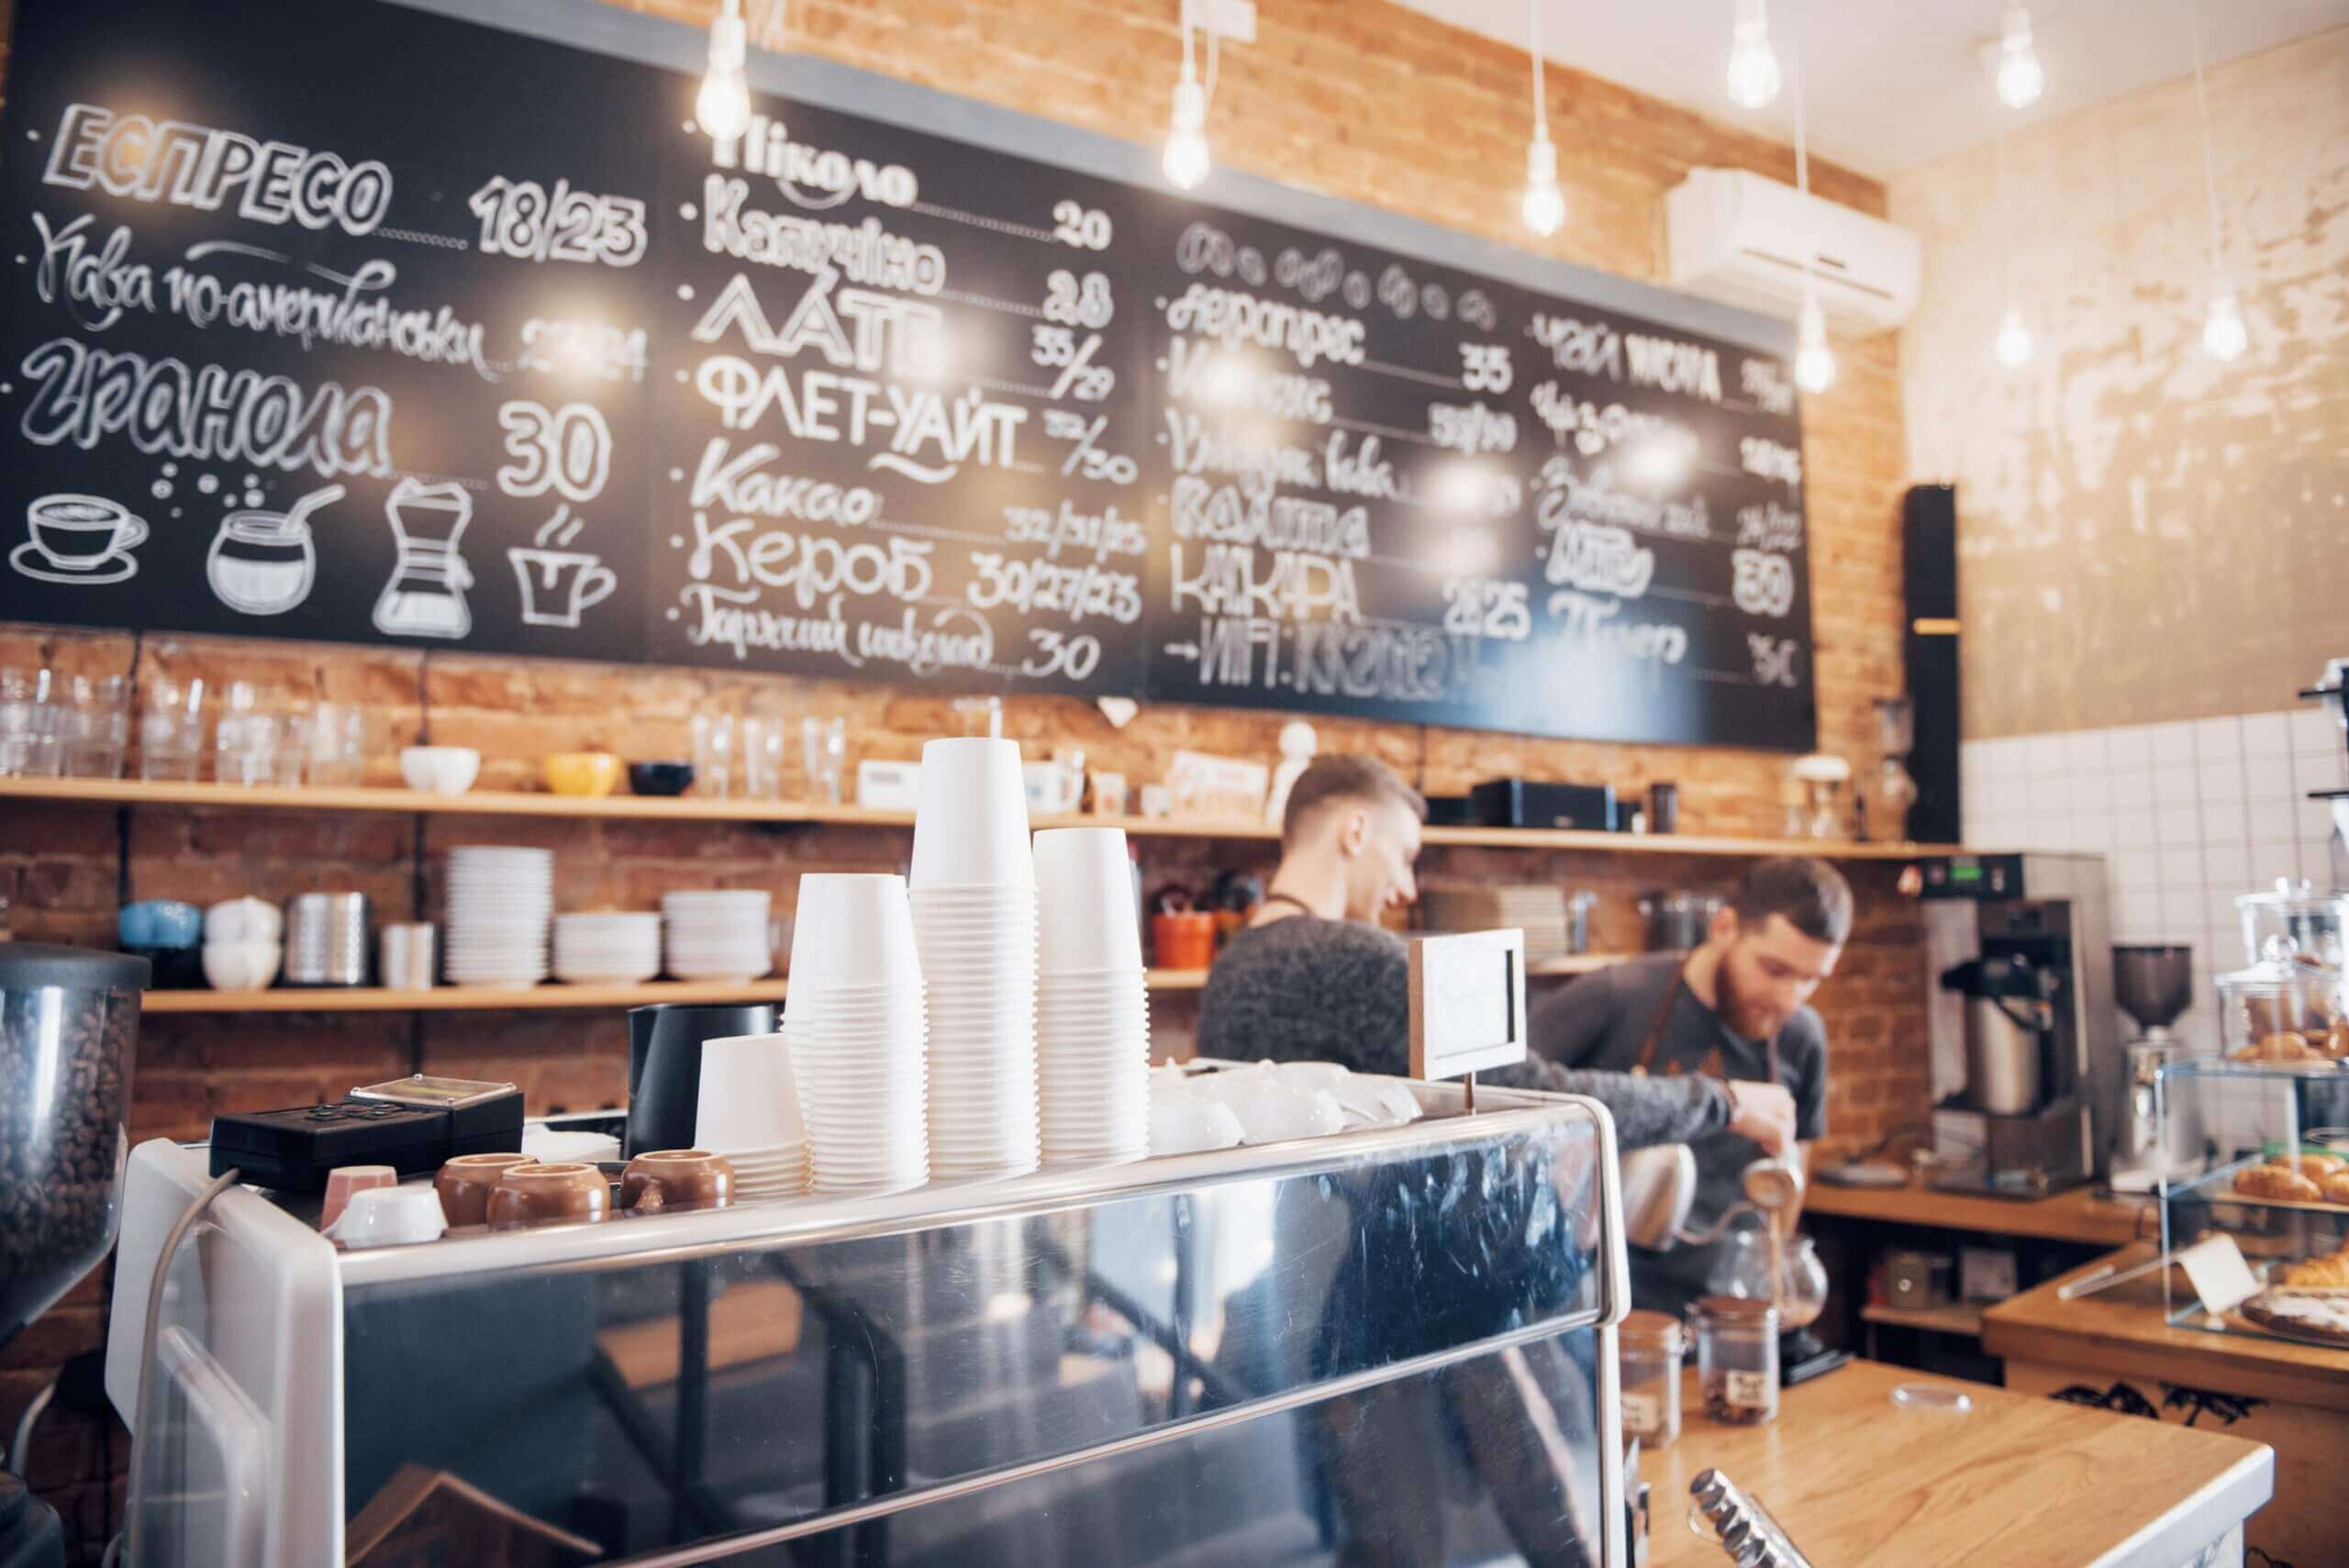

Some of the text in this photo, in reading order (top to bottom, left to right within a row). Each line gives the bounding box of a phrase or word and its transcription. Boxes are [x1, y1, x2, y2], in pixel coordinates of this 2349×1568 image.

[42, 104, 648, 266] ЕСПРЕСО 18/23
[1052, 199, 1113, 250] 20
[33, 212, 155, 332] Кава
[497, 401, 612, 501] 30
[689, 437, 882, 527] Какао
[689, 511, 934, 609] Кероб
[1021, 628, 1101, 681] 30
